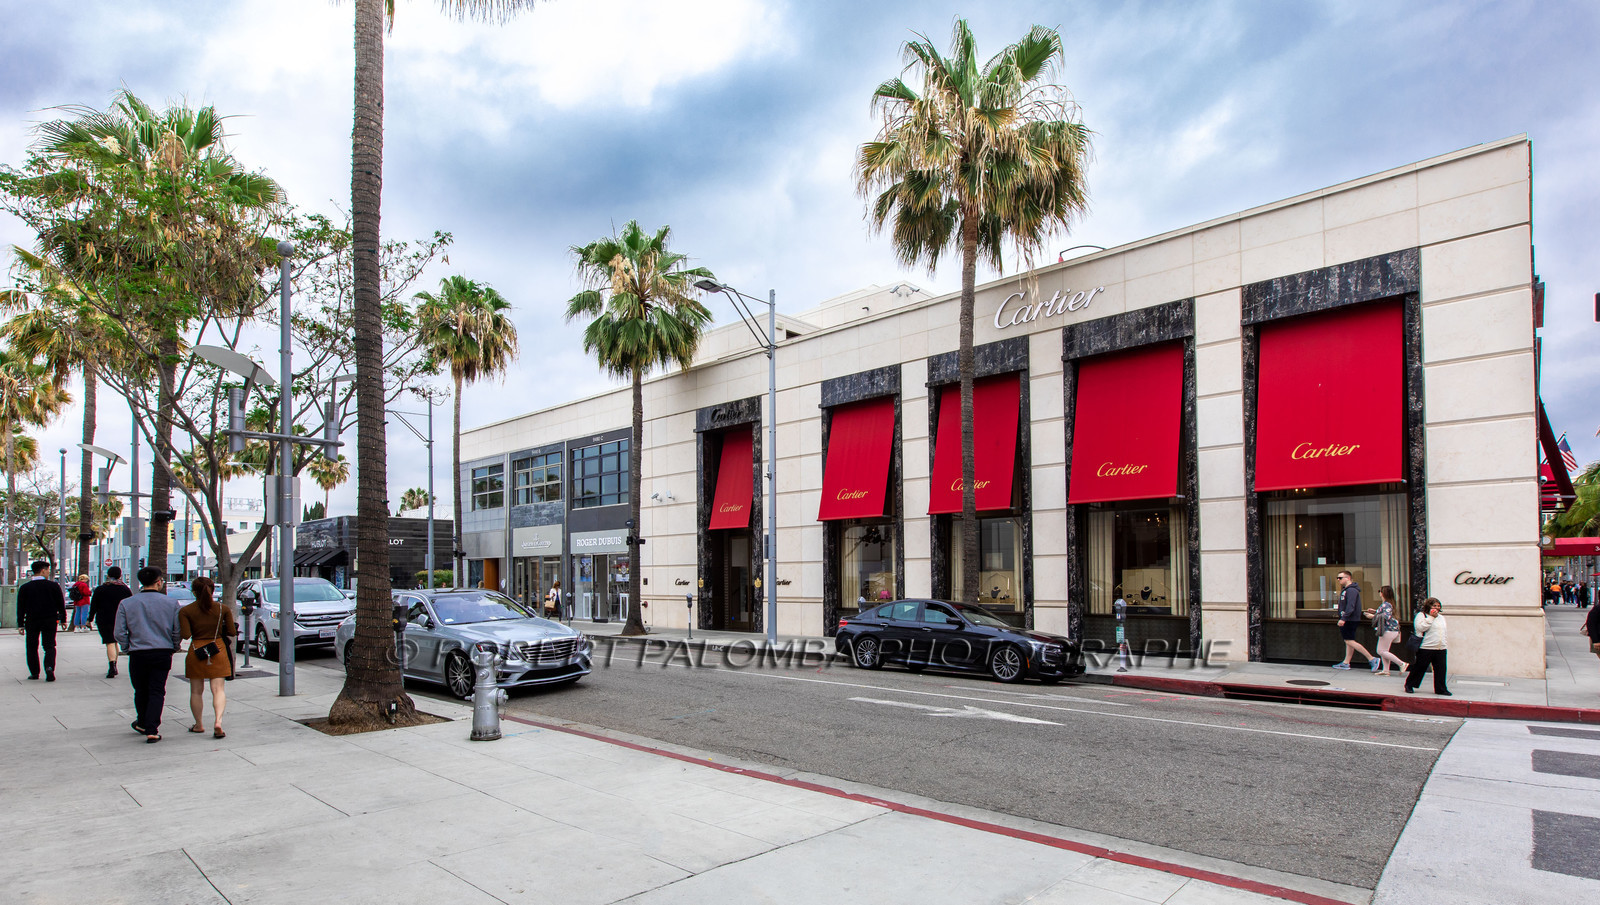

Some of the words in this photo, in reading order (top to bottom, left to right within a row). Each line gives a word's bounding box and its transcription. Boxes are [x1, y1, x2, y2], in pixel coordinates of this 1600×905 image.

[994, 286, 1105, 329] Cartier
[711, 408, 744, 423] Cartier
[1291, 442, 1361, 461] Cartier
[1096, 462, 1148, 478] Cartier
[836, 488, 869, 501] Cartier
[719, 503, 744, 513] Cartier
[576, 538, 597, 547] ROGER
[598, 536, 622, 546] DUBUIS
[675, 578, 690, 586] Cartier
[1454, 570, 1515, 586] Cartier
